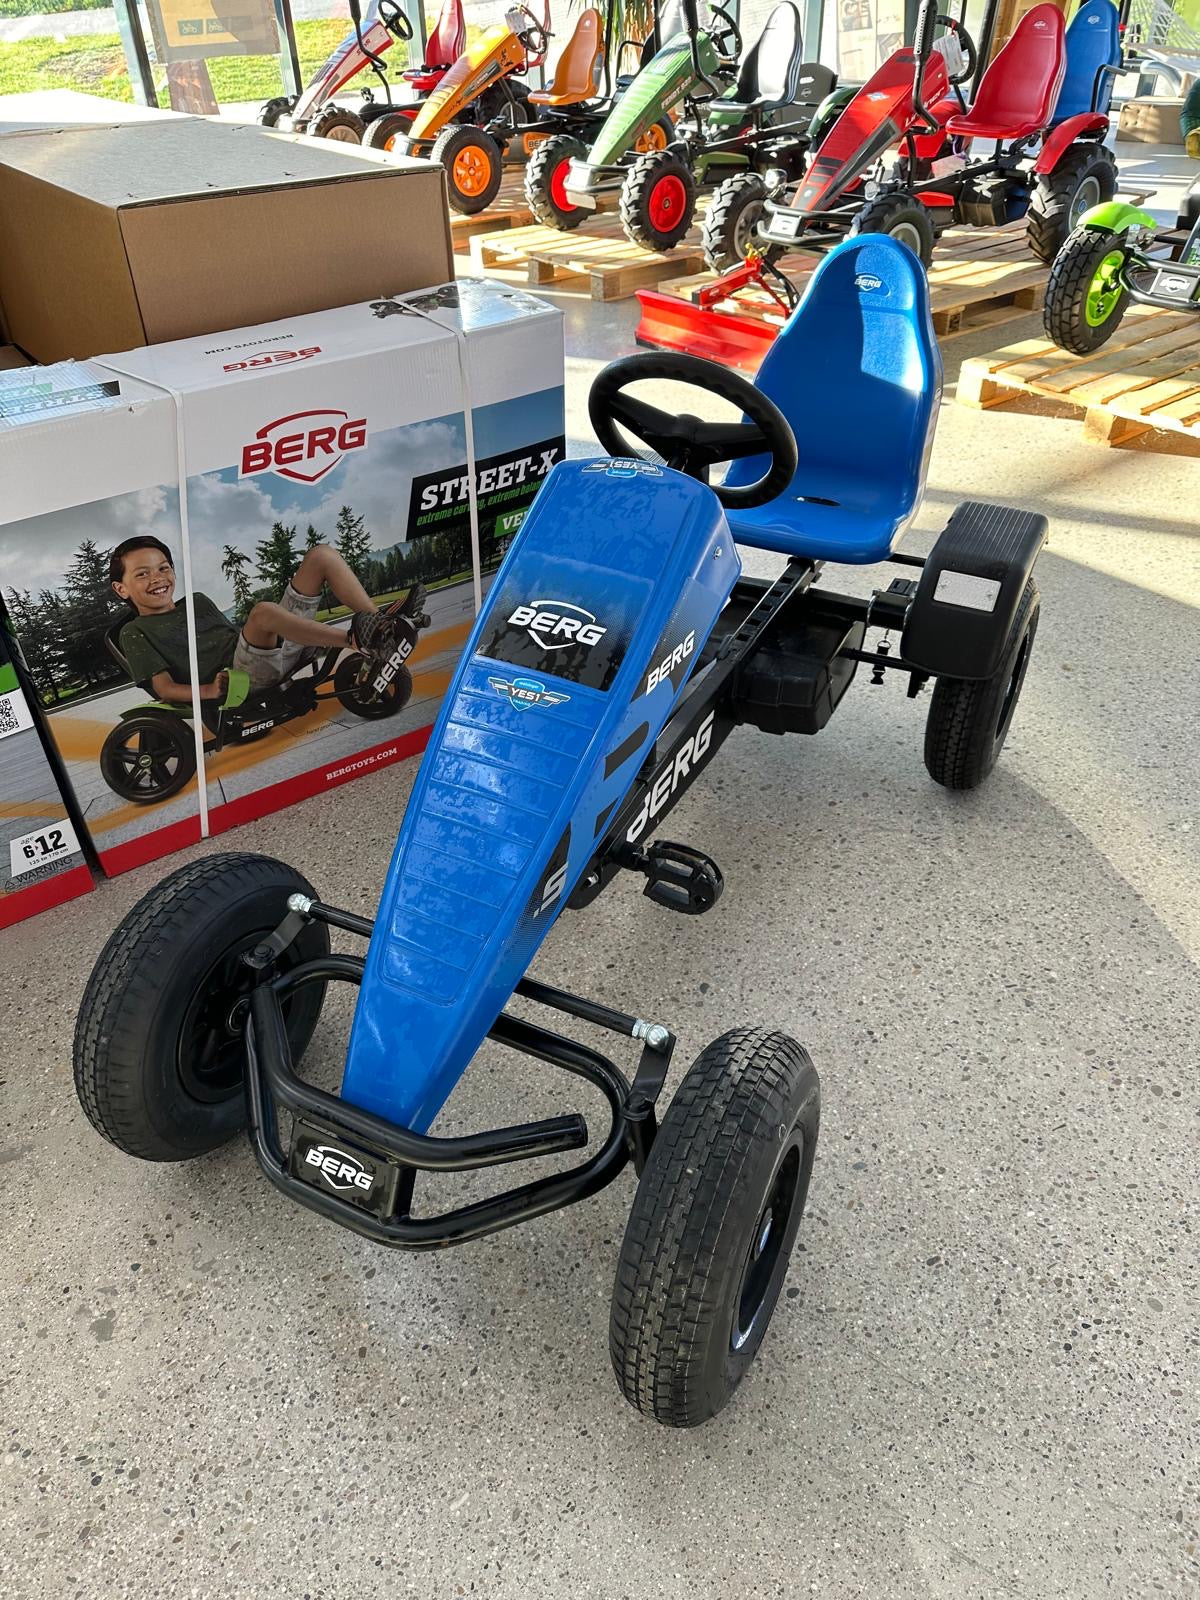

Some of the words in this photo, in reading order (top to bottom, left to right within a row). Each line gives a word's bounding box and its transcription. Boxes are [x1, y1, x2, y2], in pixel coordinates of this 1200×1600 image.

[854, 279, 882, 288] BERG
[223, 346, 322, 372] BERG
[241, 418, 367, 475] BERG
[416, 507, 453, 527] extreme
[488, 487, 522, 506] extreme
[507, 606, 607, 647] BERG
[372, 638, 413, 694] BERG
[645, 629, 696, 697] BERG
[511, 687, 541, 702] YES1
[241, 719, 274, 737] BERG
[326, 747, 397, 781] BERGTOYS.COM
[16, 855, 73, 883] WARNING
[305, 1148, 374, 1191] BERG
